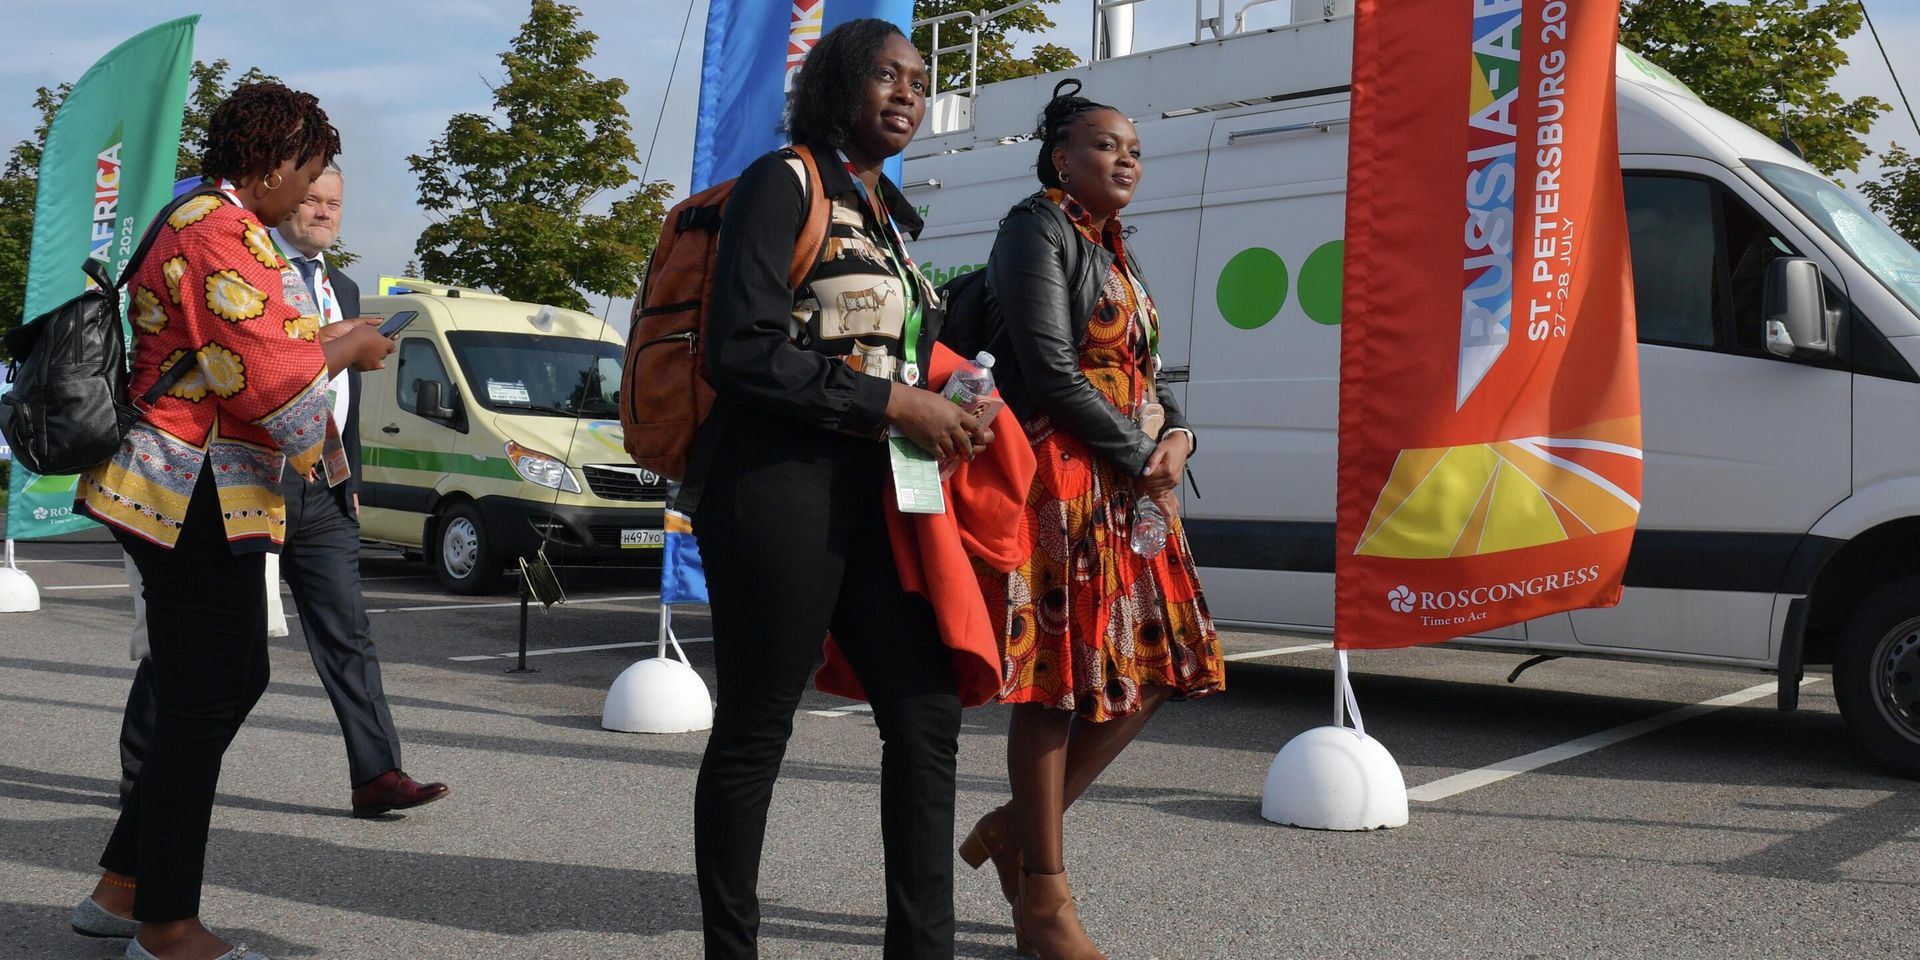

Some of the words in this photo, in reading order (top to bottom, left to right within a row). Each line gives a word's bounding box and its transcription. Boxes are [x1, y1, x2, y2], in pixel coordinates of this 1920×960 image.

[1541, 0, 1567, 44] 20
[1533, 50, 1566, 282] PETERSBURG
[118, 216, 134, 256] 2023
[1560, 217, 1574, 267] JULY
[1528, 291, 1552, 341] ST.
[1420, 565, 1599, 611] ROSCONGRESS
[1421, 615, 1451, 626] Time
[1453, 615, 1465, 624] to
[1467, 611, 1488, 621] Act
